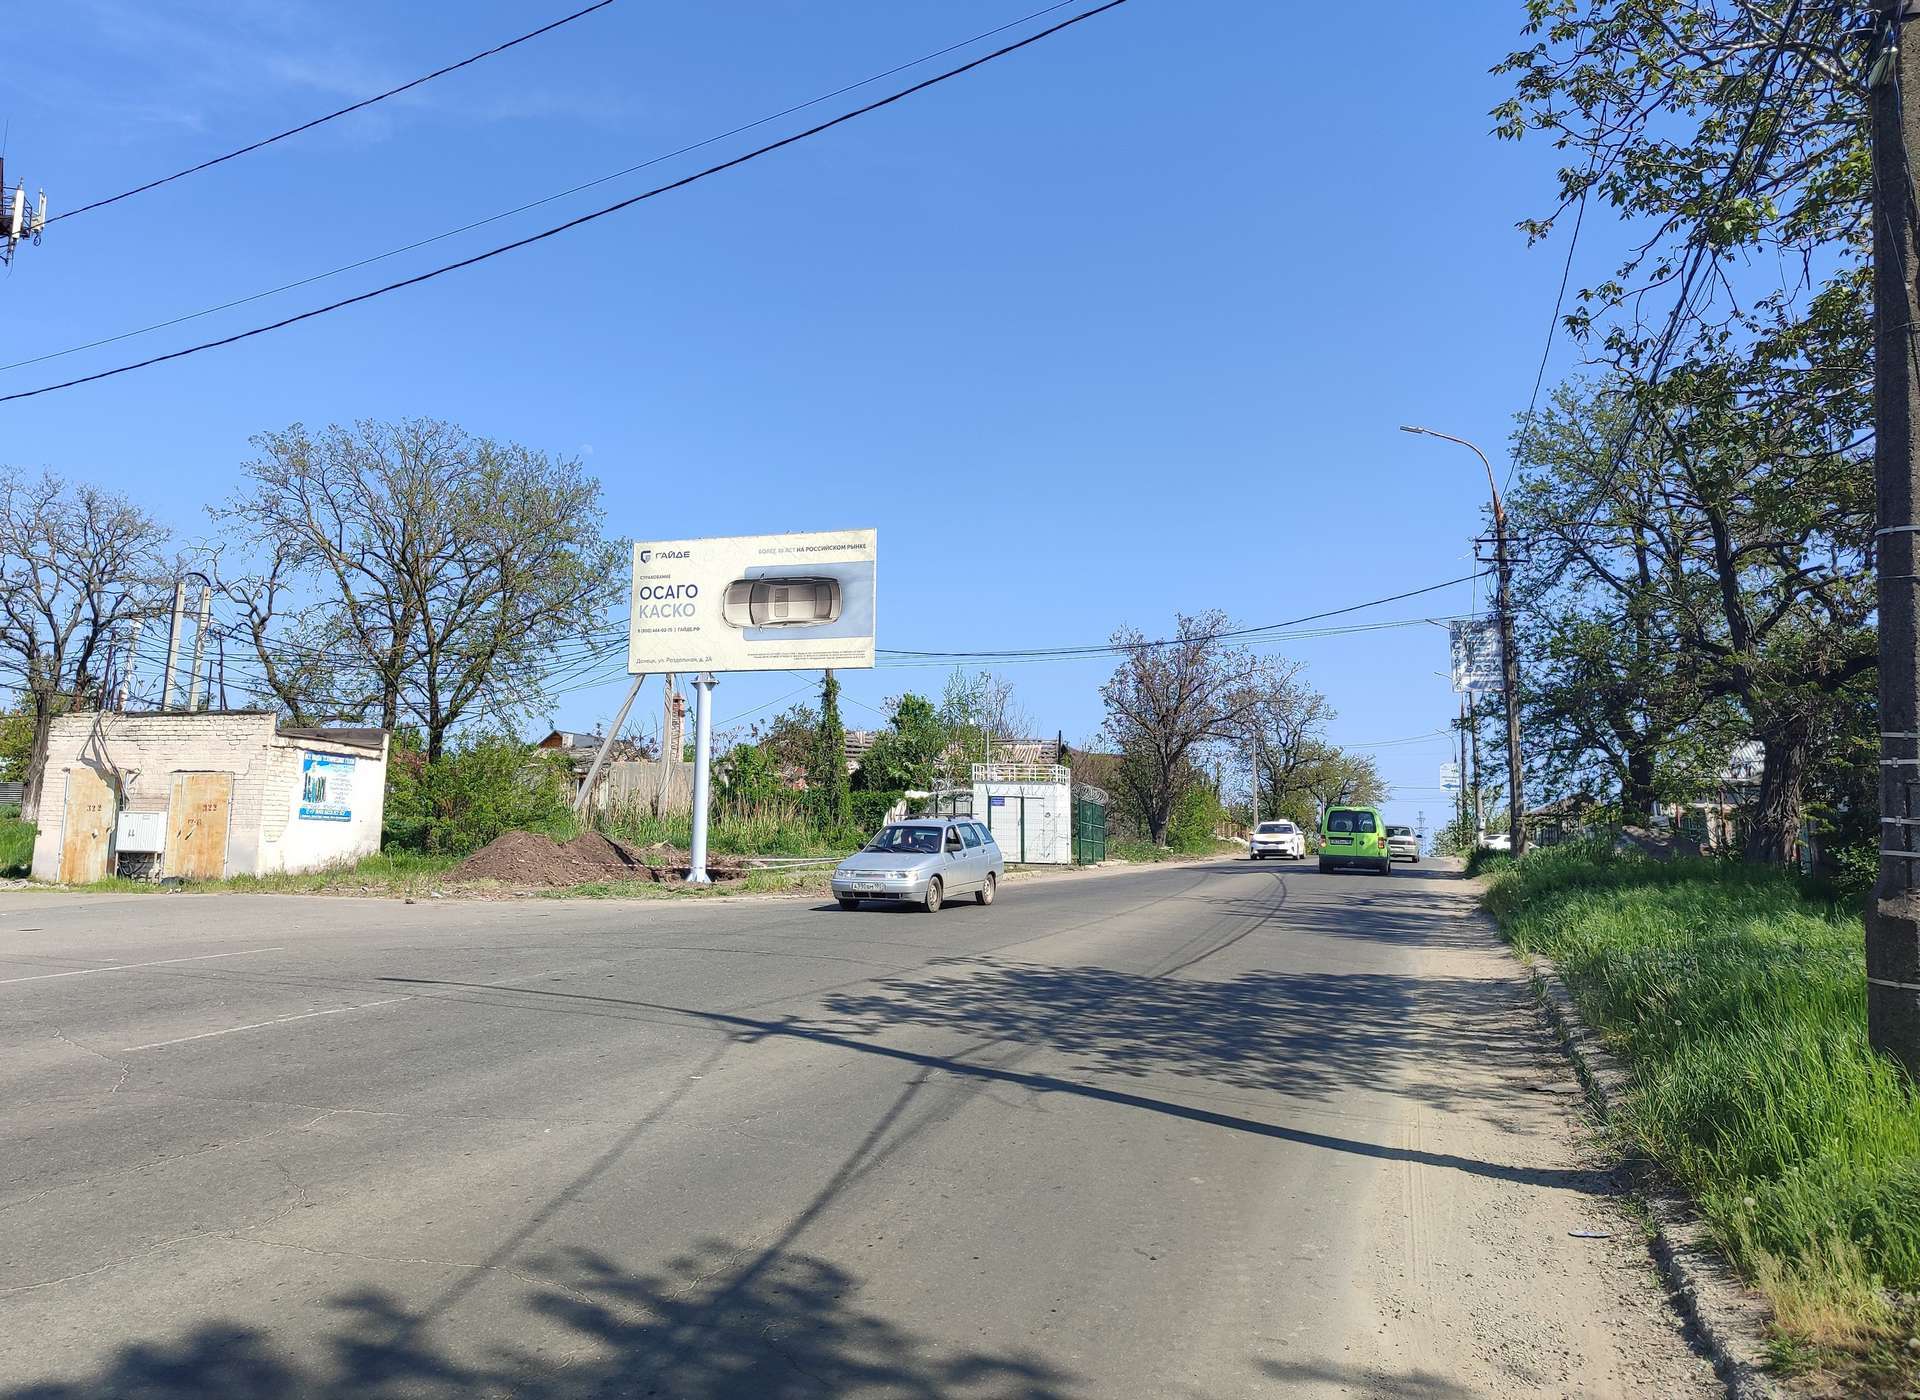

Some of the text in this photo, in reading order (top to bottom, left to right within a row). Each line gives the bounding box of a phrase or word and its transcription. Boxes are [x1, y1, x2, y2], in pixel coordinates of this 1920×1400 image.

[806, 544, 846, 552] РОССИЙСКОМ
[655, 551, 691, 559] ГАЙДЕ
[640, 584, 698, 600] ОСАГО
[639, 603, 696, 618] КАСКО
